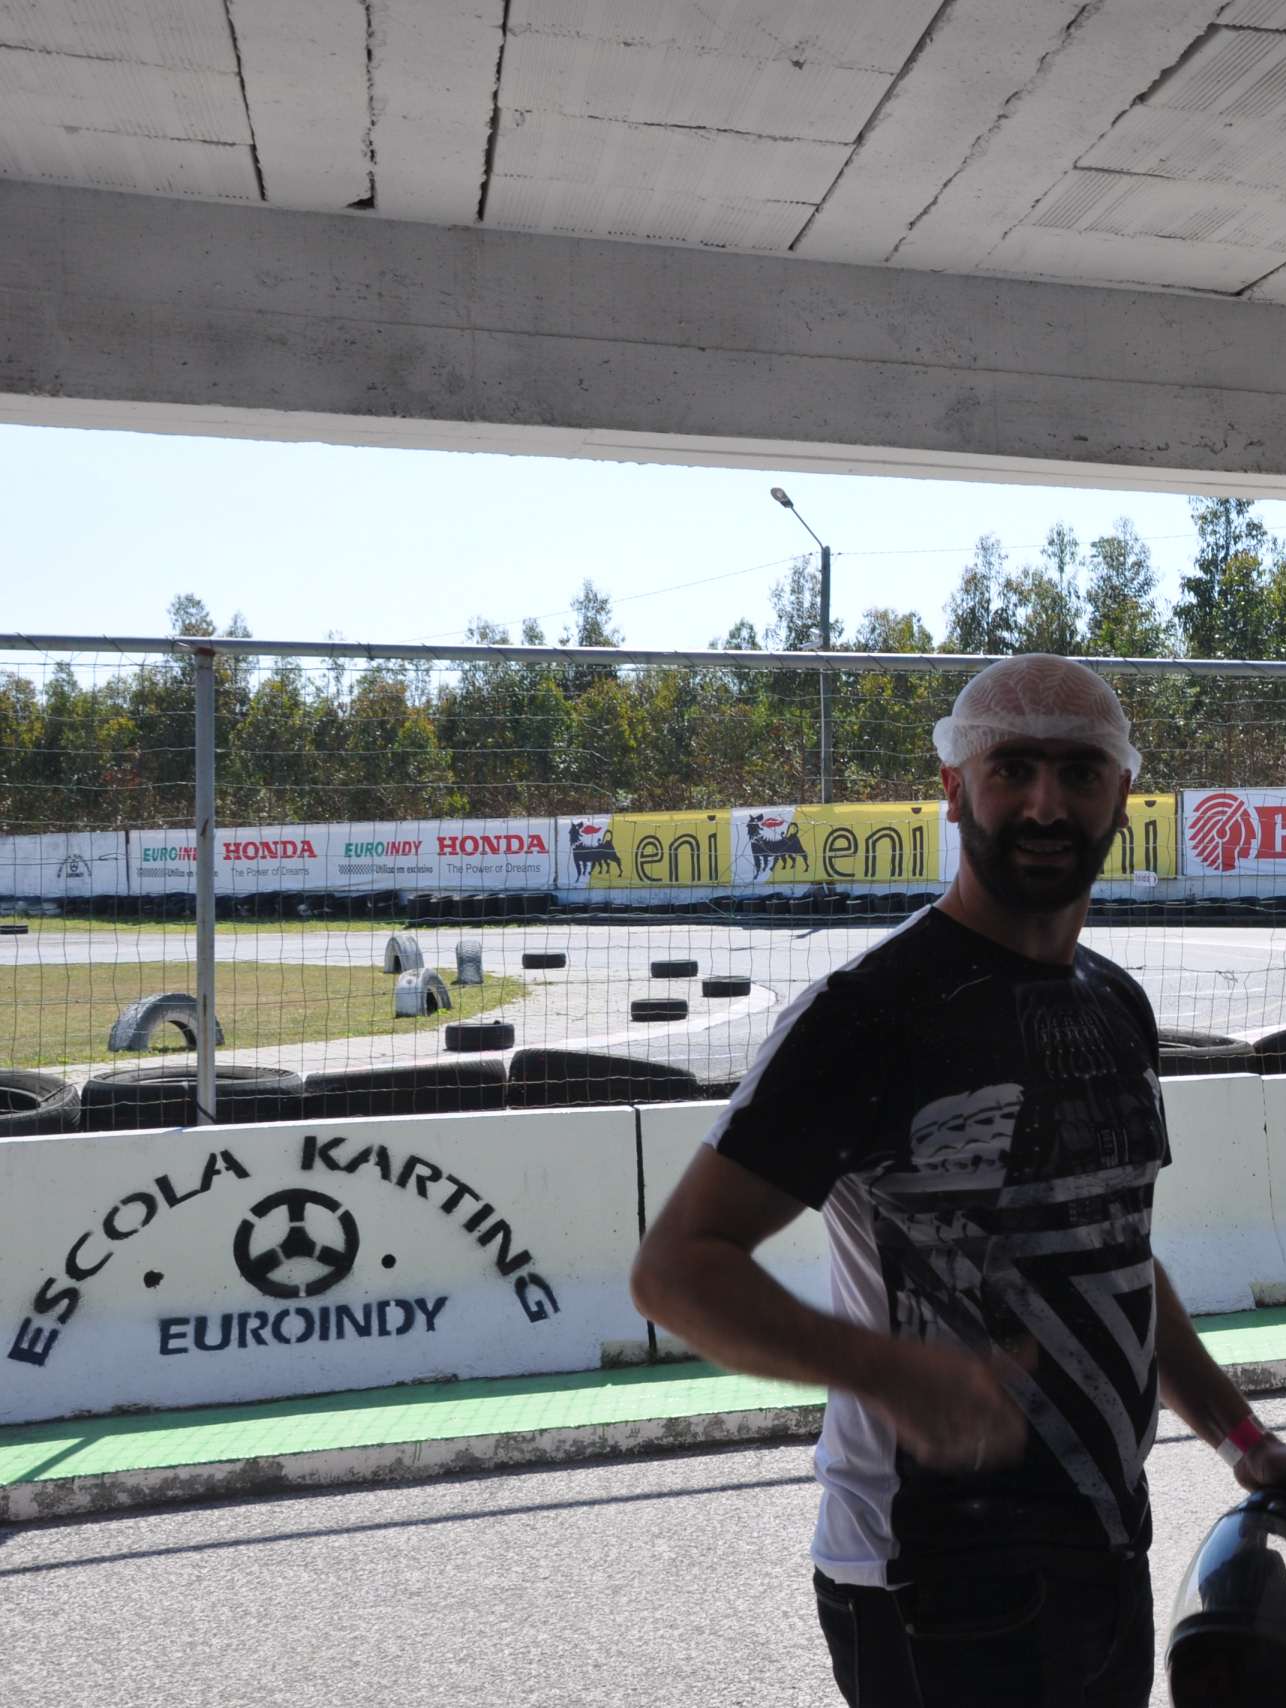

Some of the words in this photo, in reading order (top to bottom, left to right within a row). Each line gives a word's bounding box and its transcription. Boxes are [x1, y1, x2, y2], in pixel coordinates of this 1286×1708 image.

[222, 839, 318, 861] HONDA
[344, 840, 424, 859] EUROINDY
[436, 833, 551, 857] HONDA
[634, 814, 719, 883] eni
[822, 806, 925, 878] eni
[1101, 799, 1158, 875] ni
[7, 1149, 251, 1368] ESCOLA
[301, 1135, 561, 1324] KARTING
[158, 1296, 449, 1356] EUROINDY
